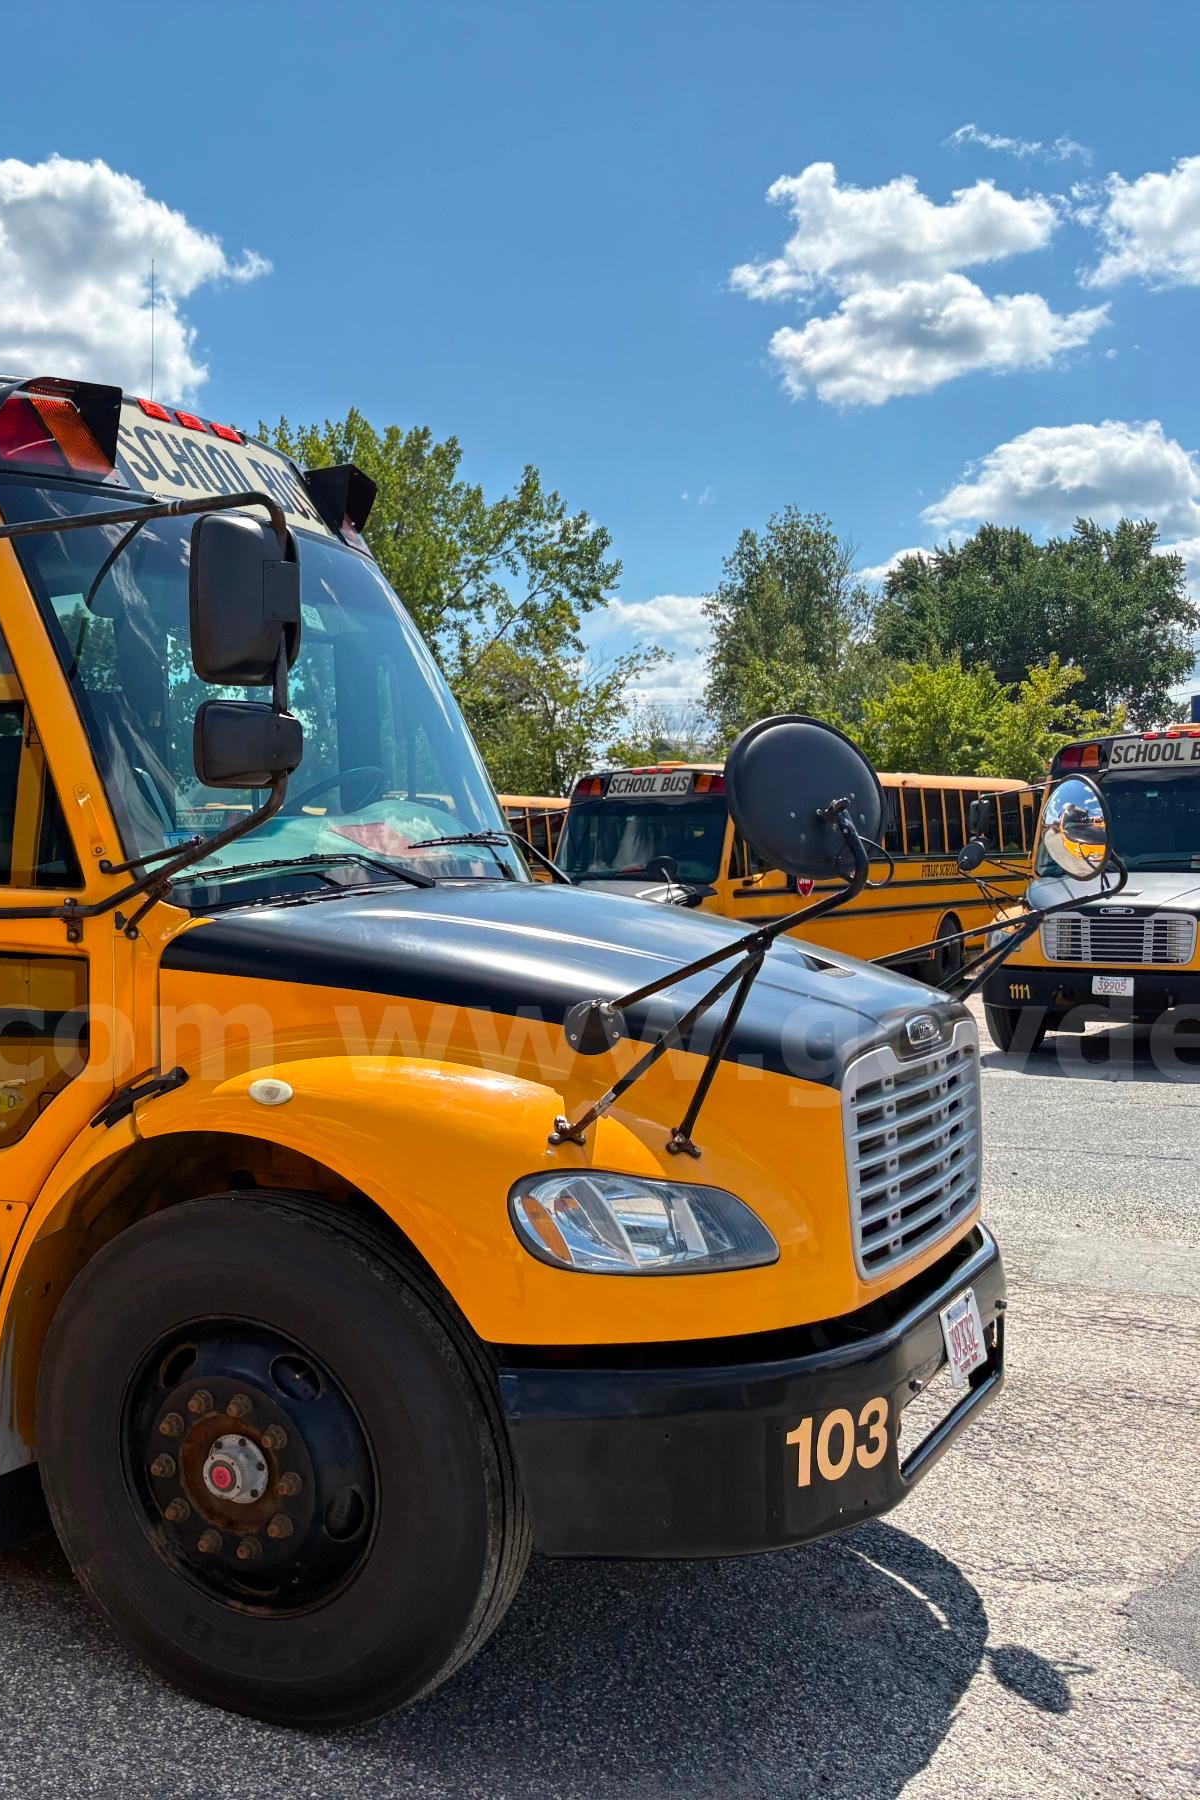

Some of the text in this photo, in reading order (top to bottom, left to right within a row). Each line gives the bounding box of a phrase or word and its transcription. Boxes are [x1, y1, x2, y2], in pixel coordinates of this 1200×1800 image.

[1111, 743, 1184, 764] SCHOOL
[609, 777, 690, 793] SCHOOL BUS
[1009, 983, 1031, 999] 1111
[786, 1397, 889, 1487] 103
